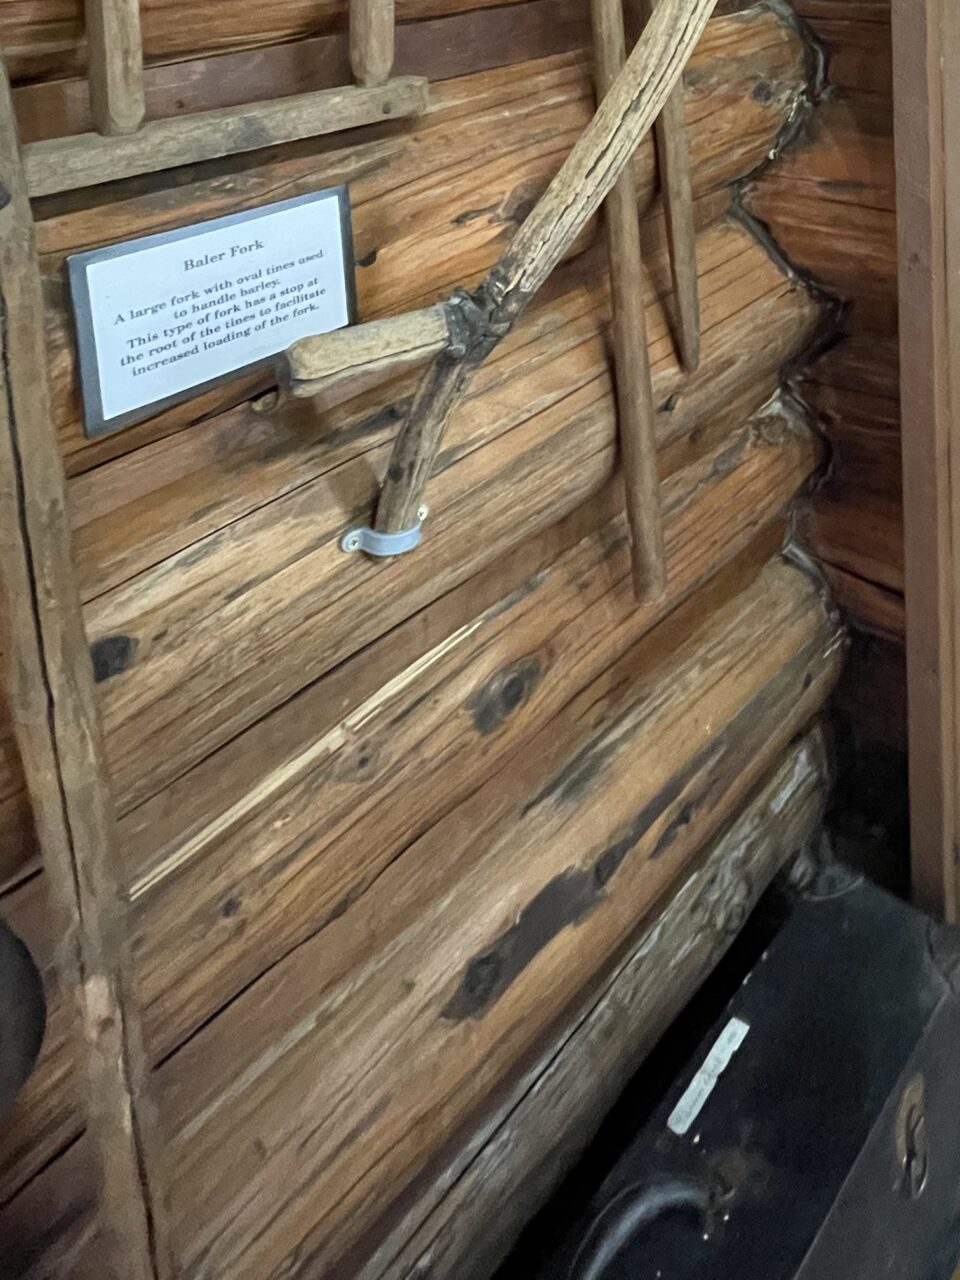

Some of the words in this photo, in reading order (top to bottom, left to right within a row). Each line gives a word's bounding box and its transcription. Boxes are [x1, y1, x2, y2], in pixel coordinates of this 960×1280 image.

[114, 313, 126, 326] A
[129, 301, 167, 320] large
[170, 289, 201, 307] fork
[203, 279, 233, 296] with
[236, 268, 262, 285] oval
[266, 260, 296, 276] tines
[298, 249, 324, 265] used
[183, 253, 226, 272] Baler
[229, 240, 265, 258] Fork
[120, 352, 144, 367] the
[149, 340, 178, 357] root
[182, 331, 197, 345] of
[200, 325, 222, 338] the
[225, 313, 256, 329] tines
[259, 307, 272, 317] to
[275, 288, 327, 312] facilitate
[126, 332, 159, 349] This
[163, 321, 193, 338] type
[197, 312, 211, 326] of
[213, 304, 242, 320] fork
[245, 296, 266, 309] has
[269, 292, 277, 301] a
[279, 283, 305, 297] stop
[307, 277, 319, 288] at
[173, 309, 188, 320] to
[191, 293, 237, 314] handle
[240, 279, 281, 297] barley.
[132, 344, 200, 377] increased
[203, 326, 252, 352] loading
[254, 320, 268, 332] of
[270, 313, 290, 326] the
[292, 303, 320, 318] fork.
